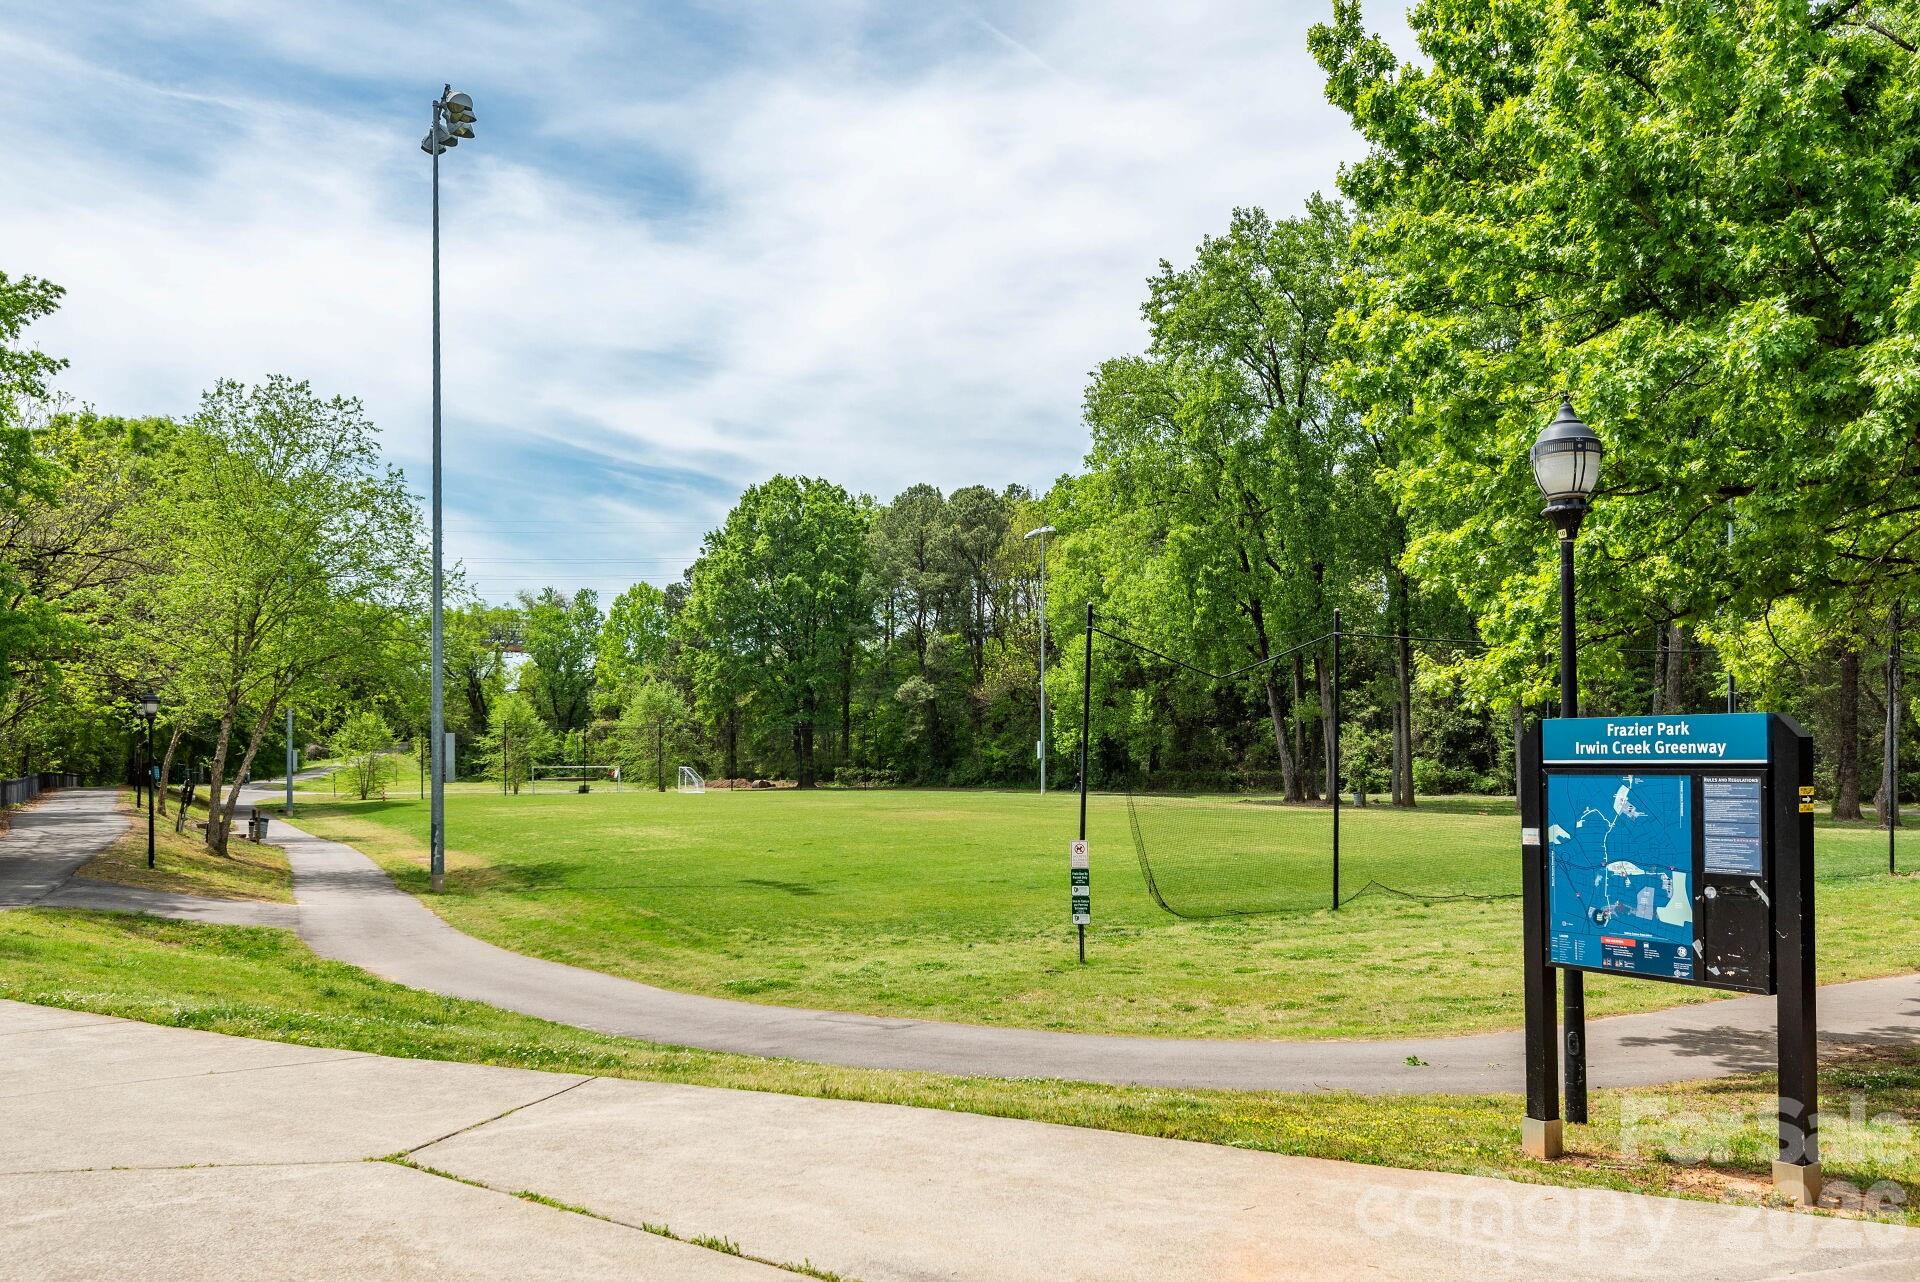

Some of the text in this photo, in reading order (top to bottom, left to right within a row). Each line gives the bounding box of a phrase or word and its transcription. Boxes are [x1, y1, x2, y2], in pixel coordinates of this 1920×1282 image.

[1607, 721, 1690, 737] Frazier Park
[1575, 740, 1726, 757] Irwin Creek Greenway
